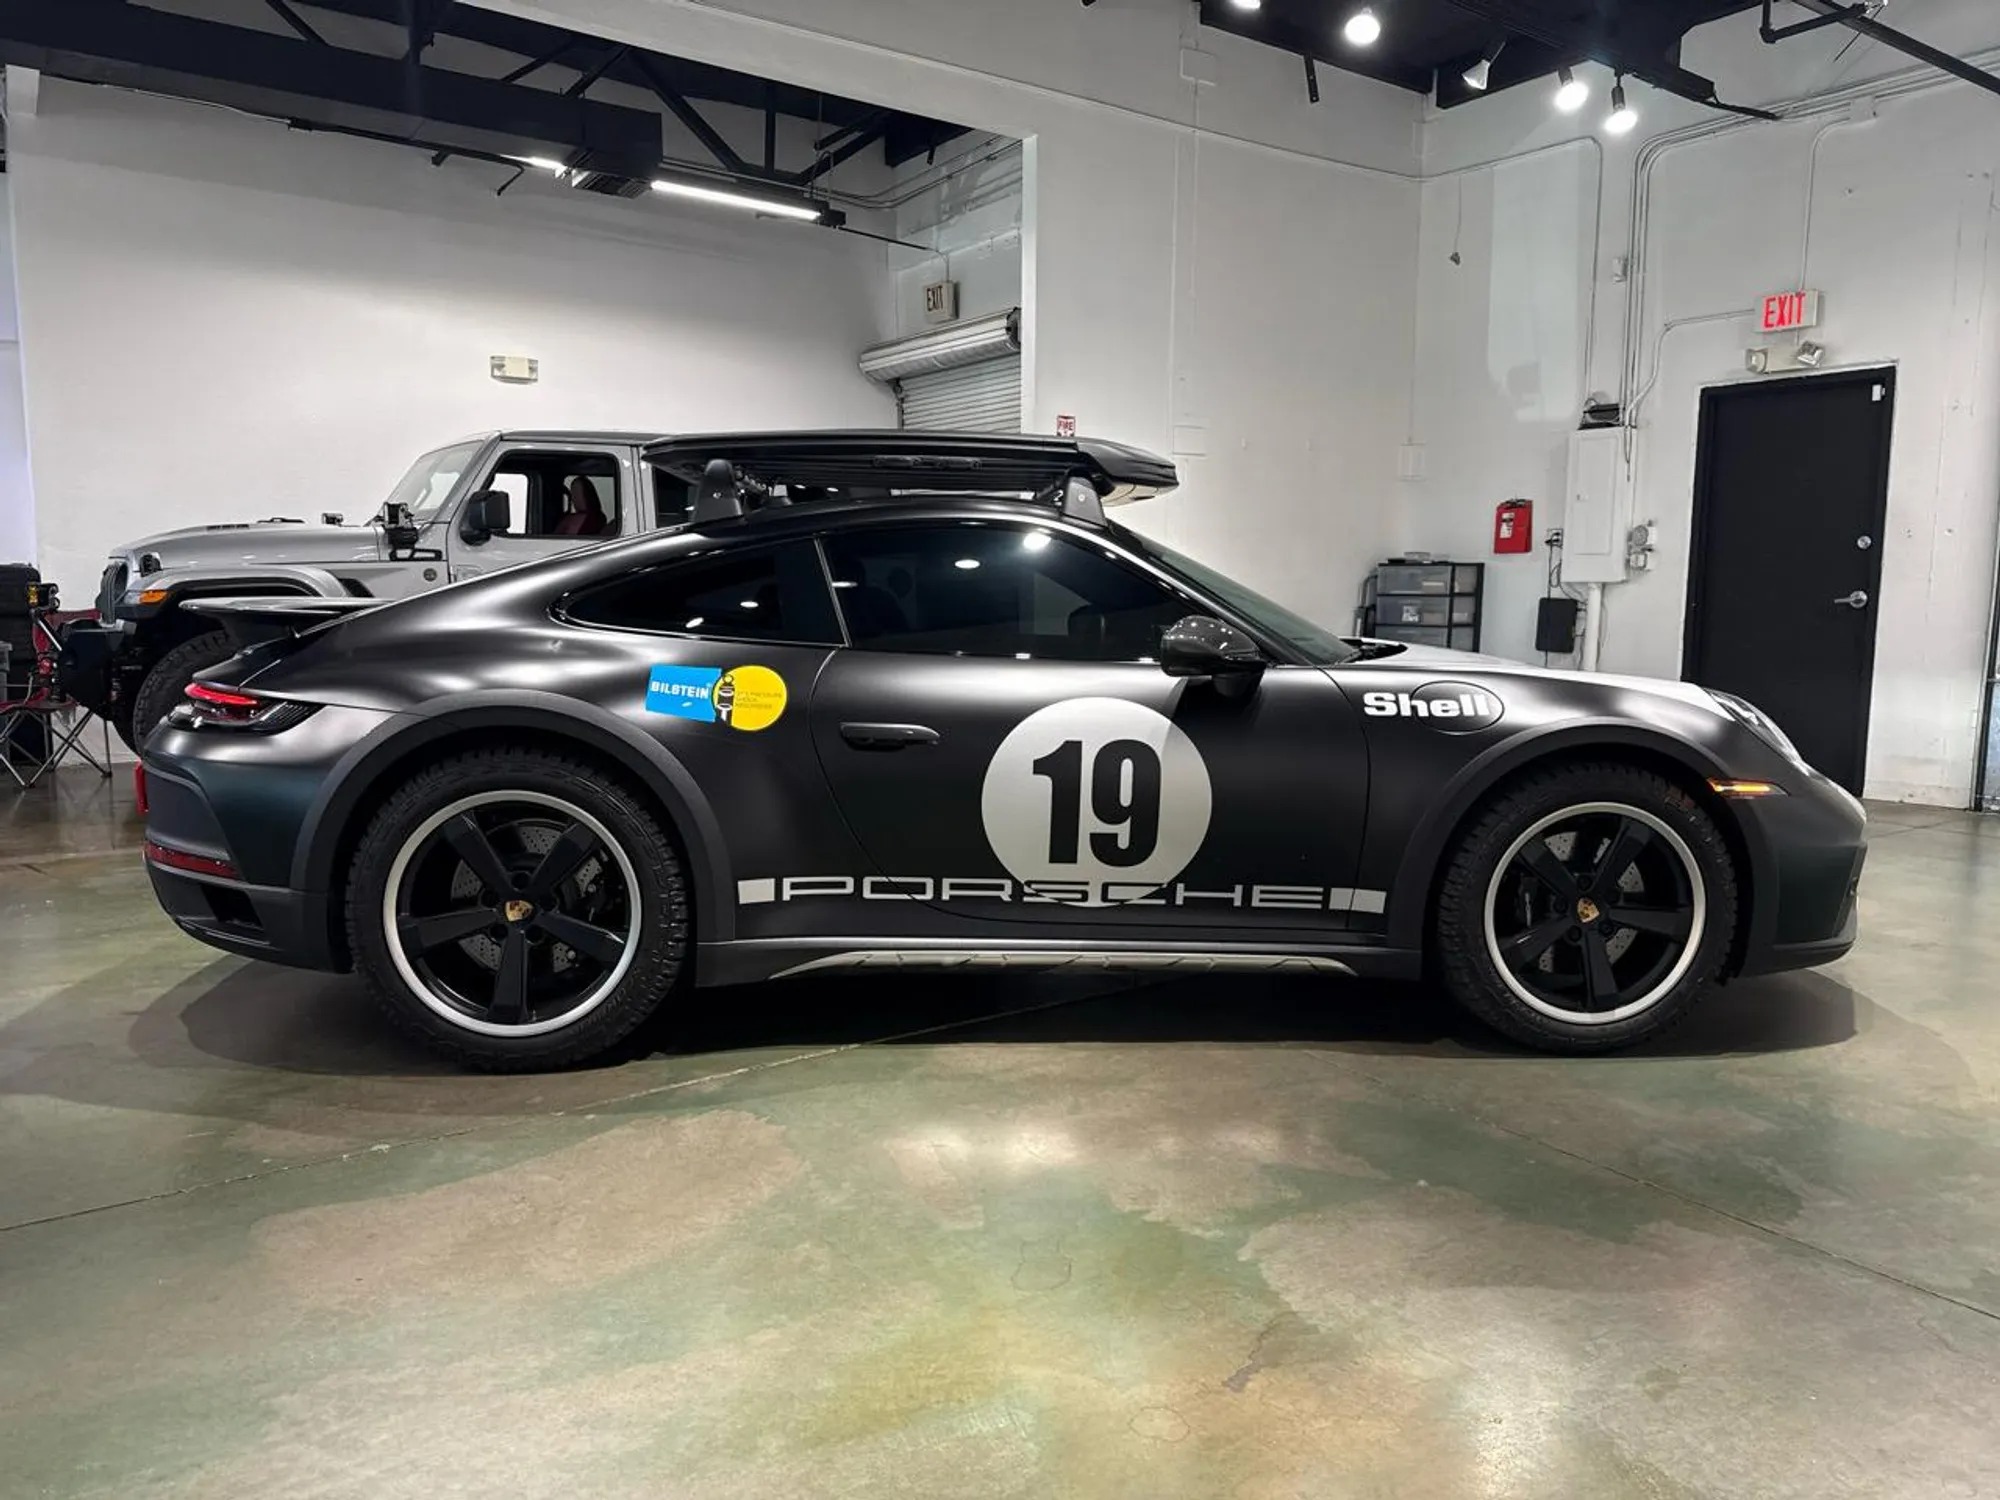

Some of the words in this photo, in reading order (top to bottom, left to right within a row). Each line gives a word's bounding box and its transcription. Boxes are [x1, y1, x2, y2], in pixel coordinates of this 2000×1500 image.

[926, 285, 944, 312] EXIT
[1763, 291, 1806, 329] EXIT
[1057, 420, 1074, 431] FIRE
[650, 680, 710, 700] BILSTEIN
[1362, 691, 1491, 717] Shell
[1032, 738, 1162, 867] 19
[782, 876, 1325, 909] PORSCHE
